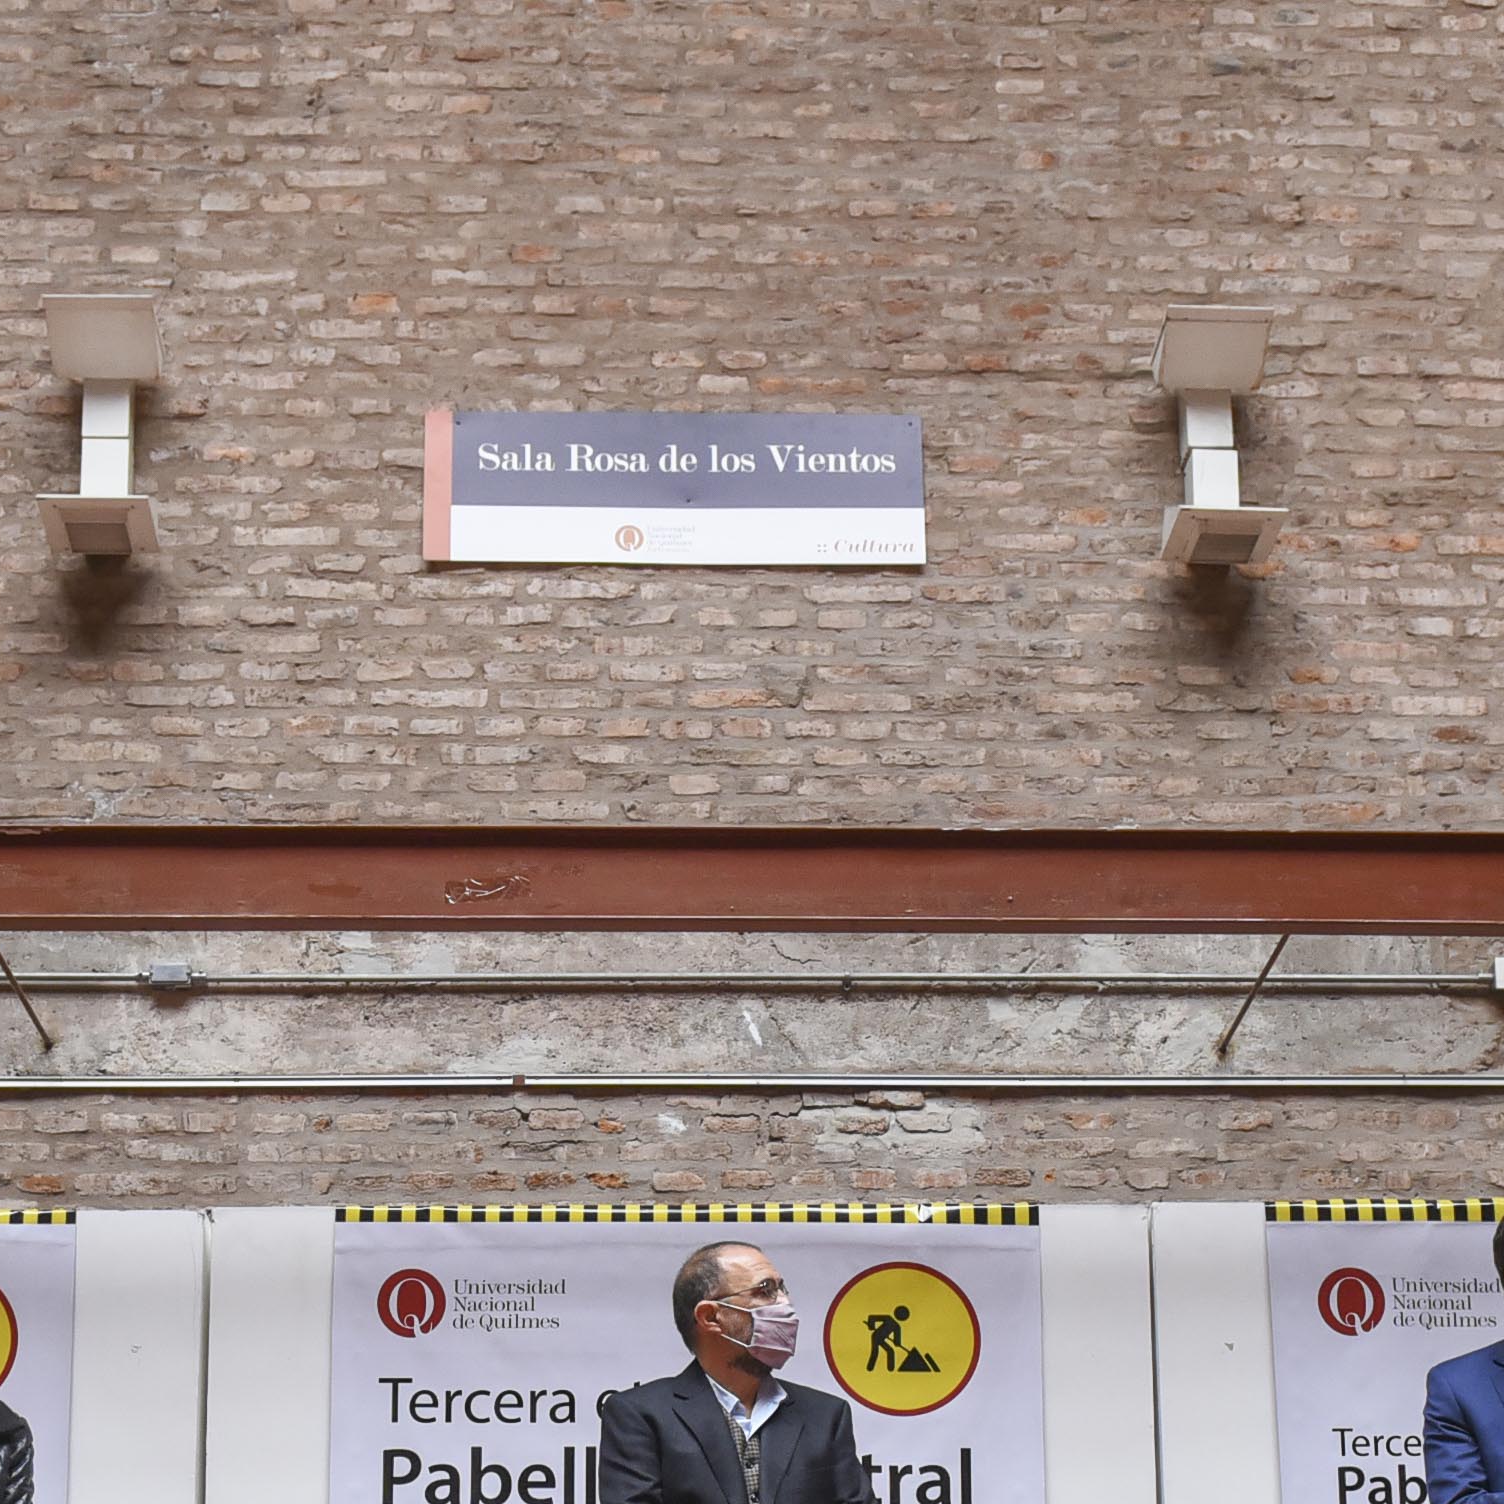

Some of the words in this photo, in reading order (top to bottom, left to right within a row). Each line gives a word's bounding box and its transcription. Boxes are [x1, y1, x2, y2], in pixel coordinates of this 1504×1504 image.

[479, 444, 555, 471] Sala
[566, 444, 649, 472] Rosa
[659, 445, 697, 472] de
[709, 445, 755, 472] los
[768, 445, 895, 472] Vientos
[834, 540, 913, 552] Cultura
[455, 1279, 565, 1294] Universidad
[1392, 1277, 1501, 1293] Universidad
[454, 1296, 534, 1312] Nacional
[1394, 1295, 1471, 1310] Nacional
[453, 1314, 474, 1329] de
[480, 1314, 559, 1332] Quilmes
[1394, 1312, 1414, 1326] de
[1419, 1312, 1496, 1330] Quilmes
[379, 1378, 575, 1423] Tercera
[1332, 1428, 1423, 1458] Terce
